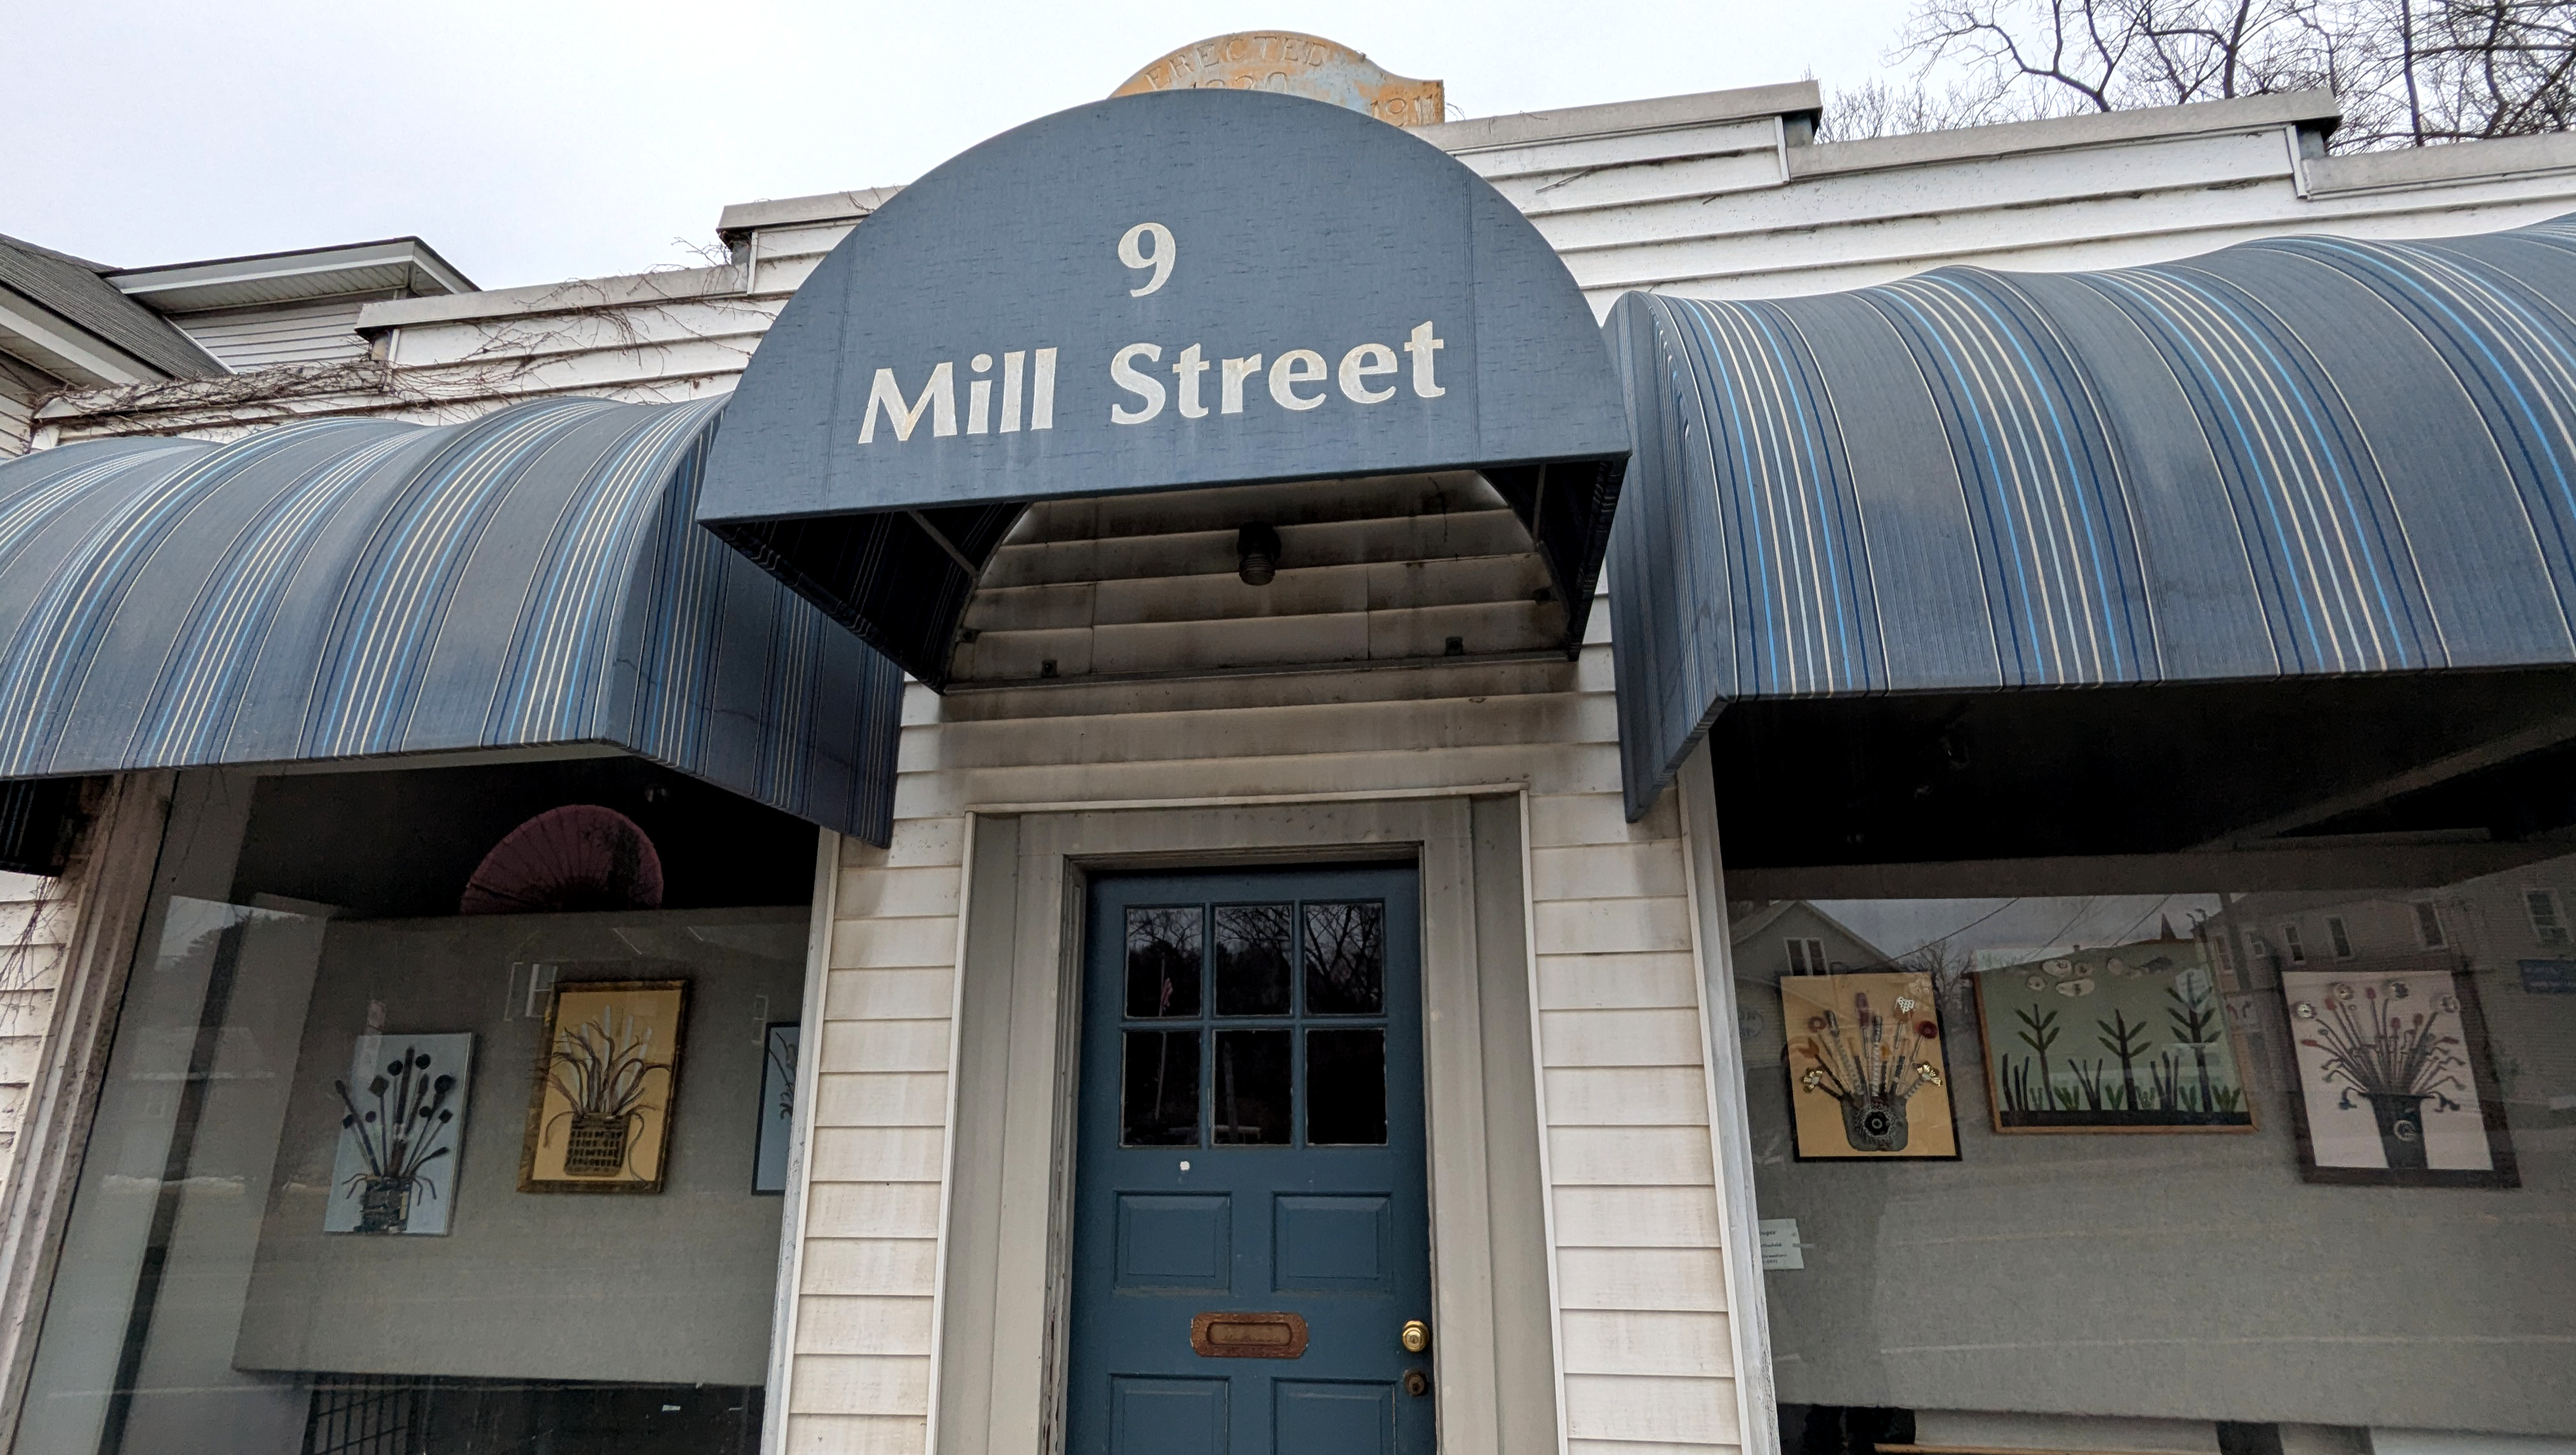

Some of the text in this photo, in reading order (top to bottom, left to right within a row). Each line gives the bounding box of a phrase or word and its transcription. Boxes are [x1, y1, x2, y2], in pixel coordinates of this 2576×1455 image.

[1146, 35, 1326, 91] ERECTED
[1117, 221, 1177, 299] 9
[857, 319, 1446, 445] Mill Street
